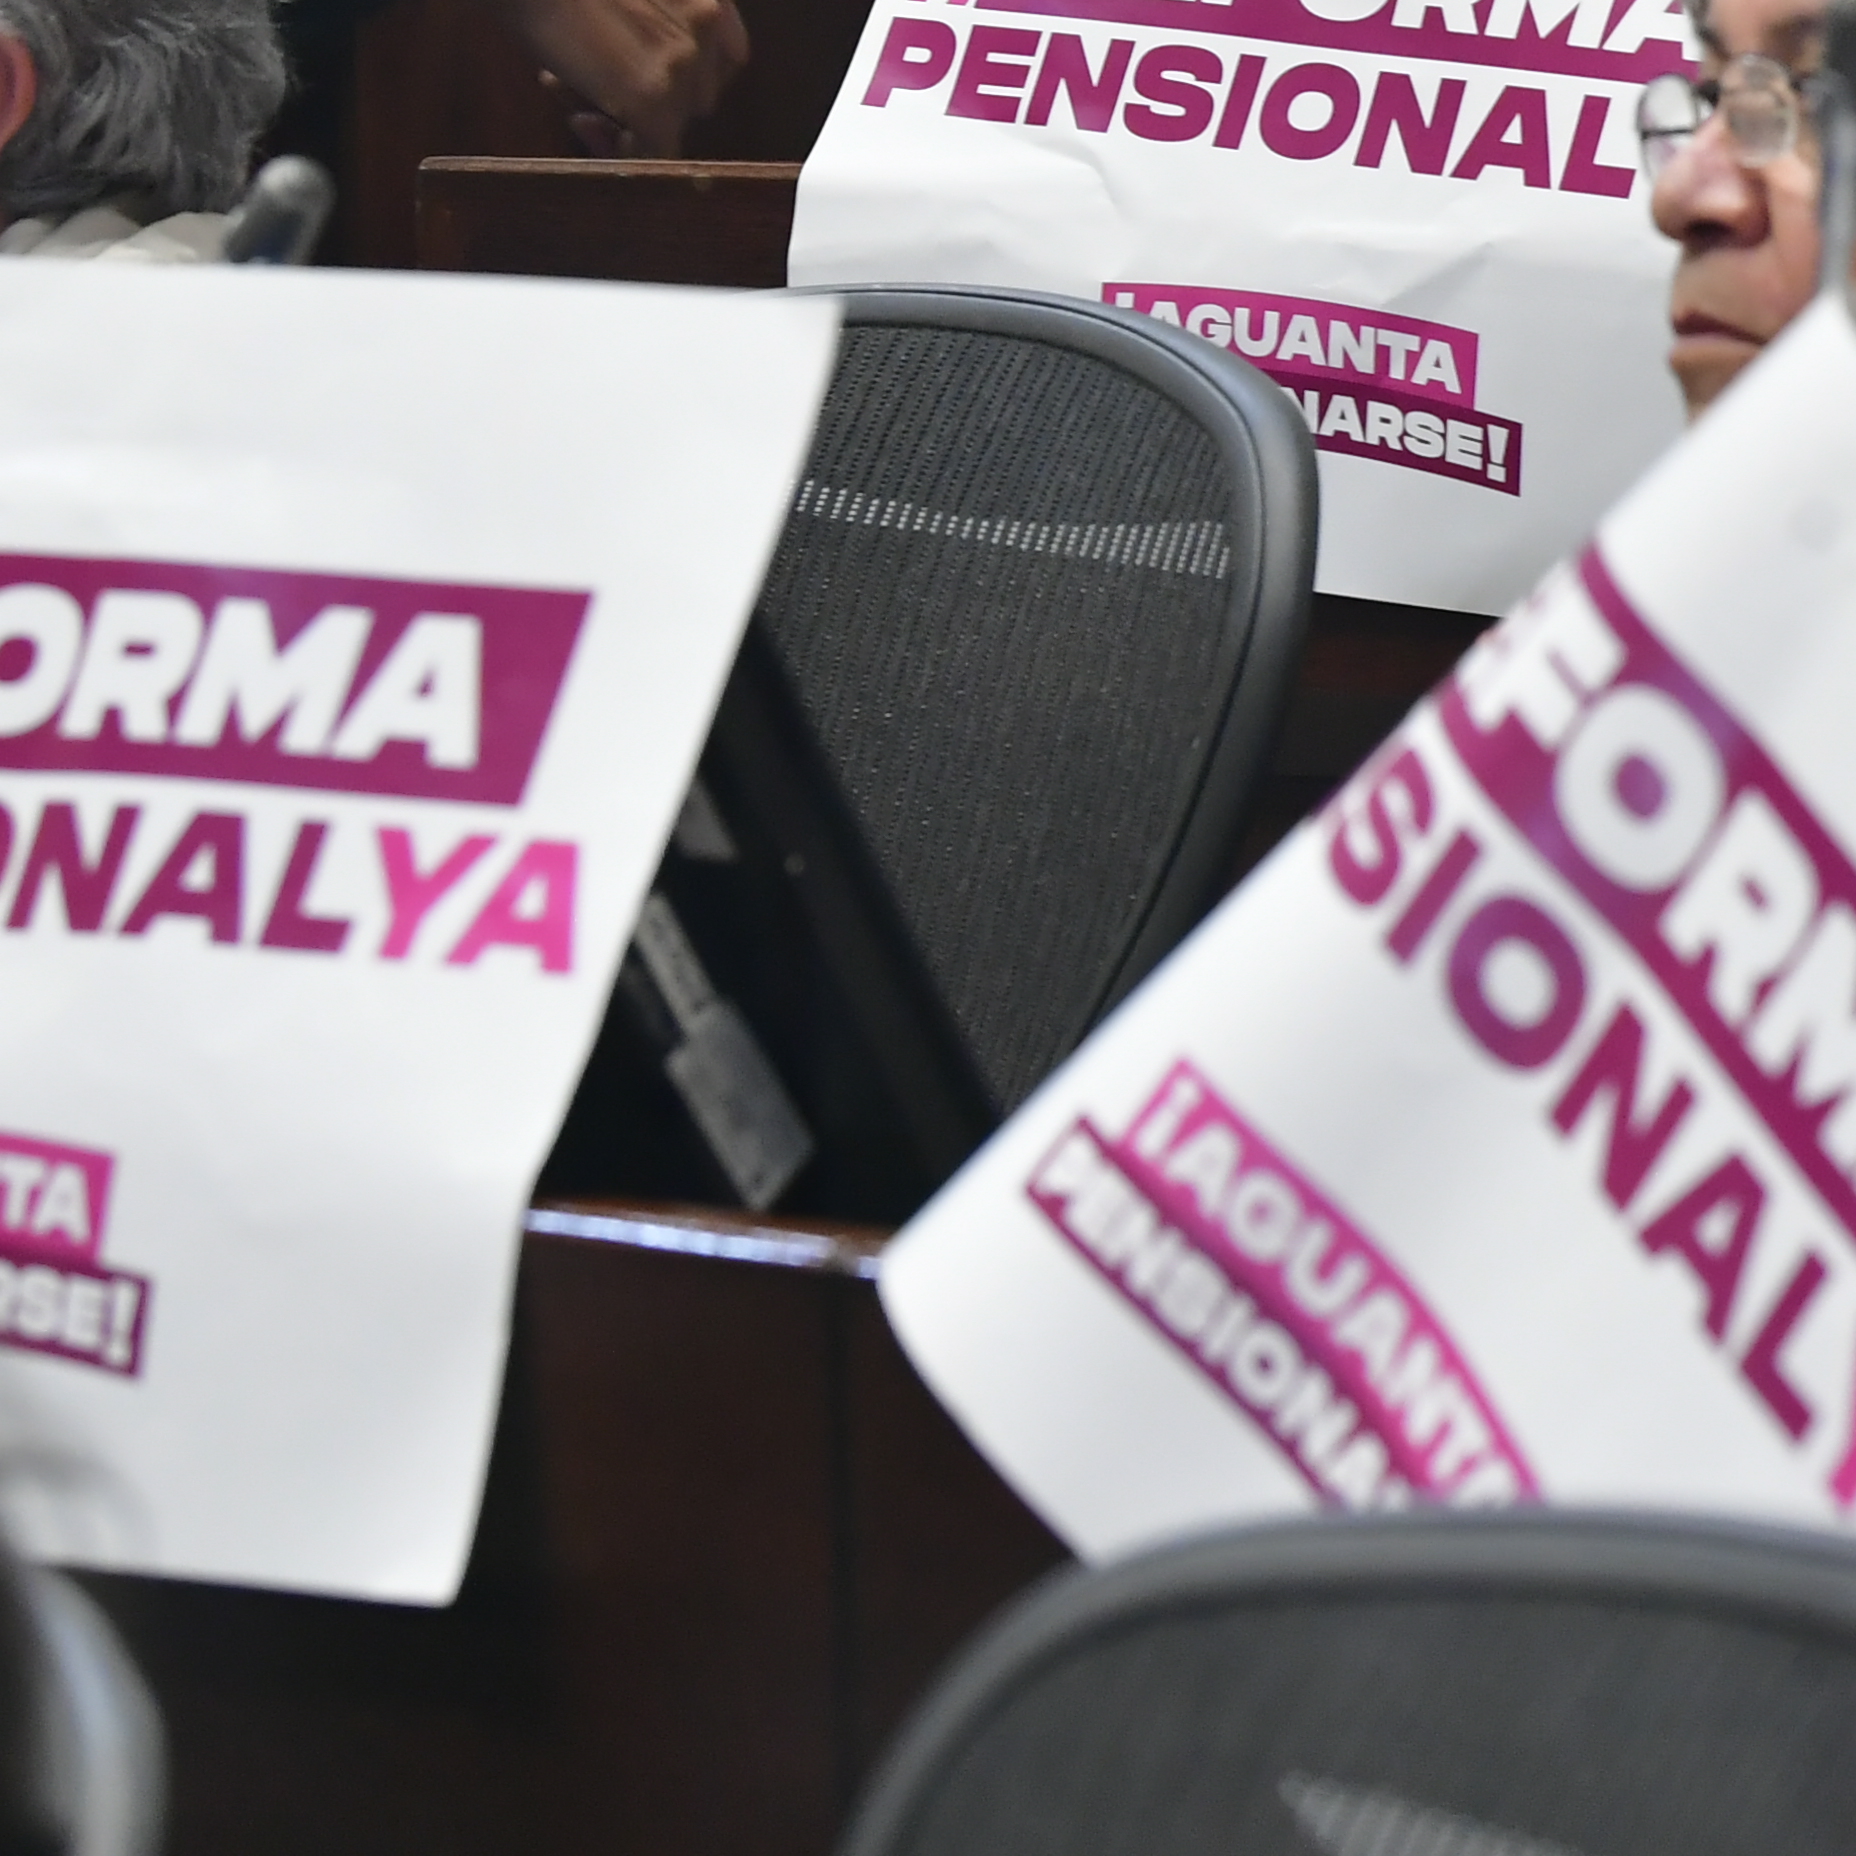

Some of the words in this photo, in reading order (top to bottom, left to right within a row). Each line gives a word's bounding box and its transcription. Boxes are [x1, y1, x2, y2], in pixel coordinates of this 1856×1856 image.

[861, 17, 1637, 199] PENSIONAL
[0, 581, 484, 773] ORMA
[0, 801, 579, 974] NALYA
